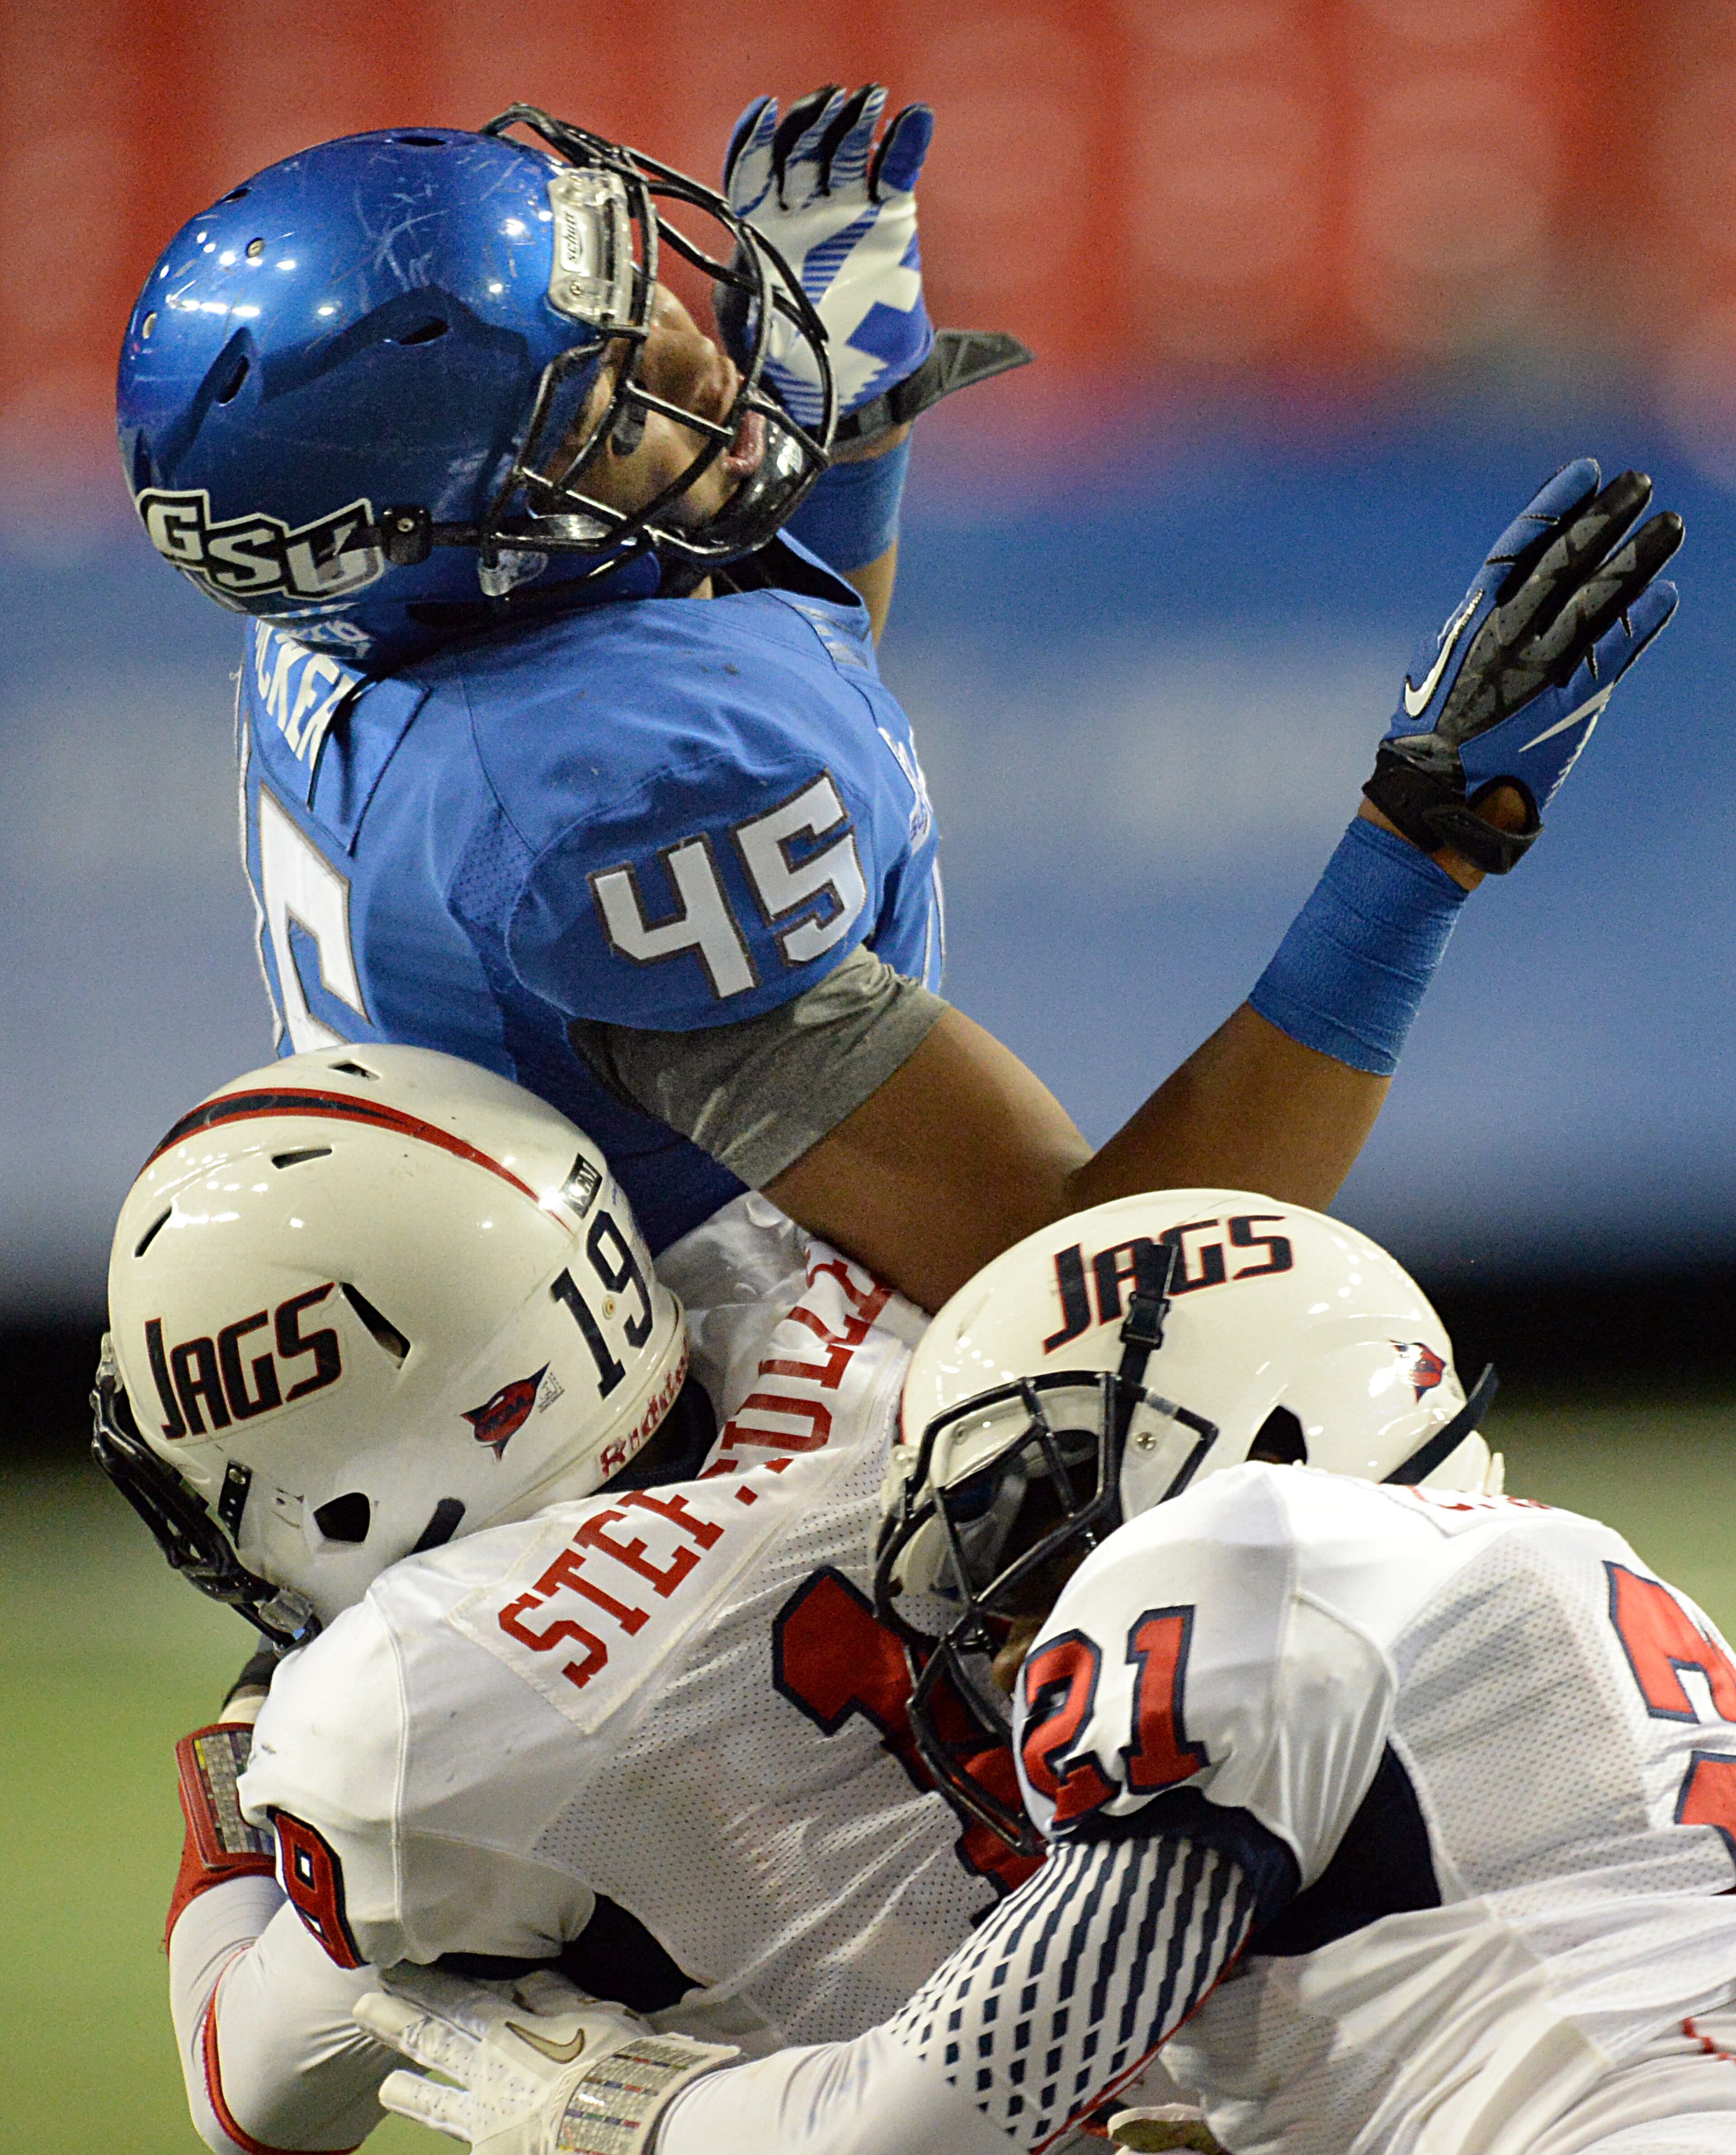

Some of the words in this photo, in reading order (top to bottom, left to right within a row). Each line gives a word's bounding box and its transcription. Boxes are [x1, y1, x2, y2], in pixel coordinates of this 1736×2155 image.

[136, 487, 386, 600] GSU
[586, 768, 867, 1000] 45
[145, 1281, 342, 1440] JAGS
[550, 1210, 653, 1400] 19
[1043, 1215, 1293, 1355] JAGS
[1022, 1604, 1212, 1830] 21
